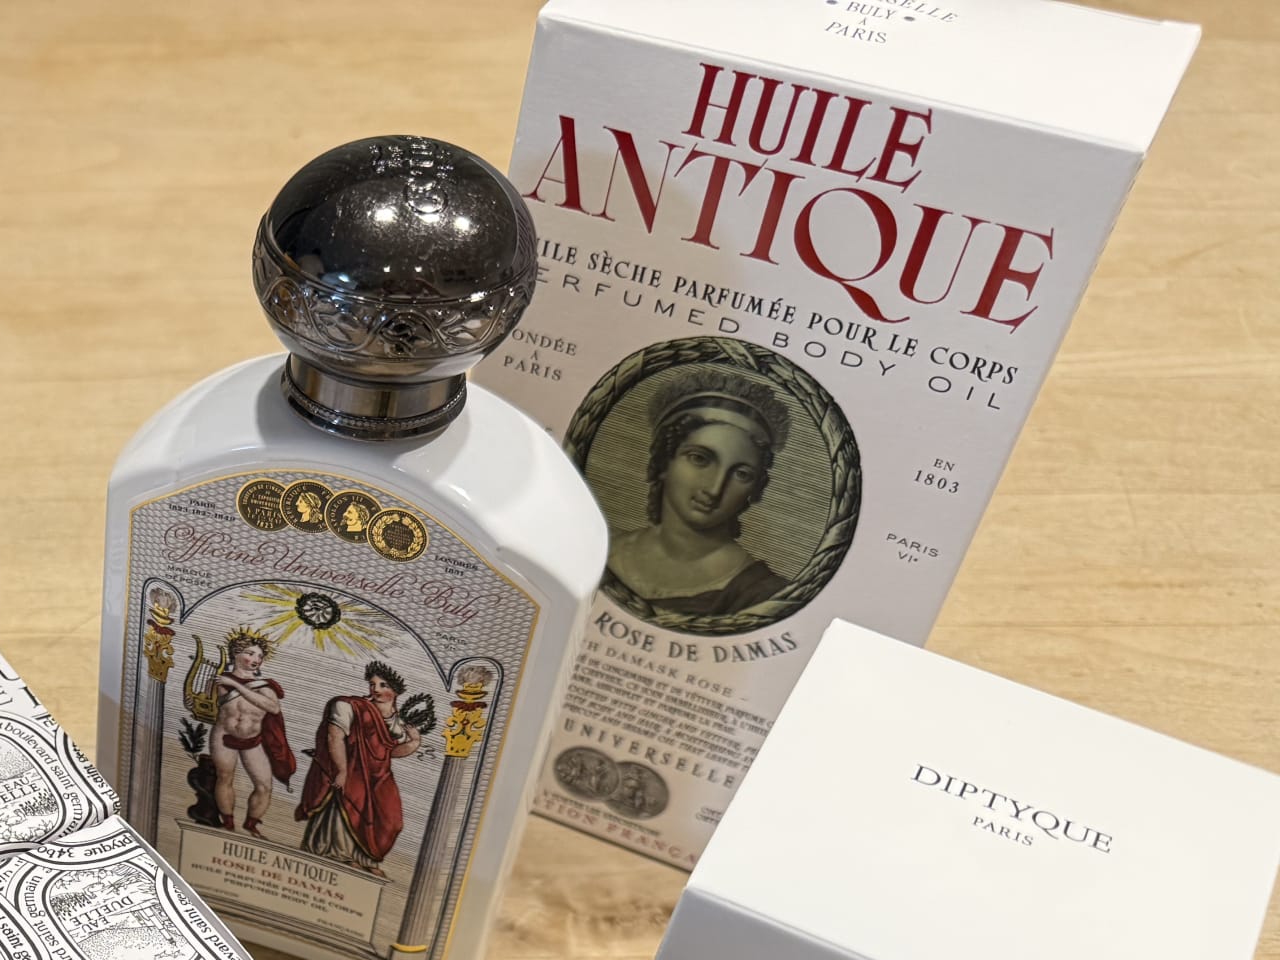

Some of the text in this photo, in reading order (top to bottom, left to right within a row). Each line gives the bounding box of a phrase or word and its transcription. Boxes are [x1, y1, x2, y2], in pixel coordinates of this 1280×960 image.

[825, 21, 887, 44] PARIS
[846, 1, 897, 20] BULY
[681, 62, 934, 195] HUILE
[521, 114, 1056, 335] ANTIQUE
[534, 269, 1003, 411] ERFUMED BODY OIL
[587, 249, 1020, 388] SÈCHE PARFUMÉE POUR LE CORPS
[504, 355, 562, 381] PARIS
[912, 469, 961, 495] 1803
[933, 457, 956, 473] EN
[885, 531, 941, 559] PARIS
[593, 610, 800, 665] ROSE DE DAMAS
[685, 673, 734, 698] ROSE
[563, 717, 737, 789] UNIVERSELLE
[909, 763, 1114, 855] DIPTYQUE
[971, 815, 1036, 847] PARIS
[212, 856, 345, 901] ROSE DE DAMAS
[223, 841, 338, 886] HUILE ANTIQUE
